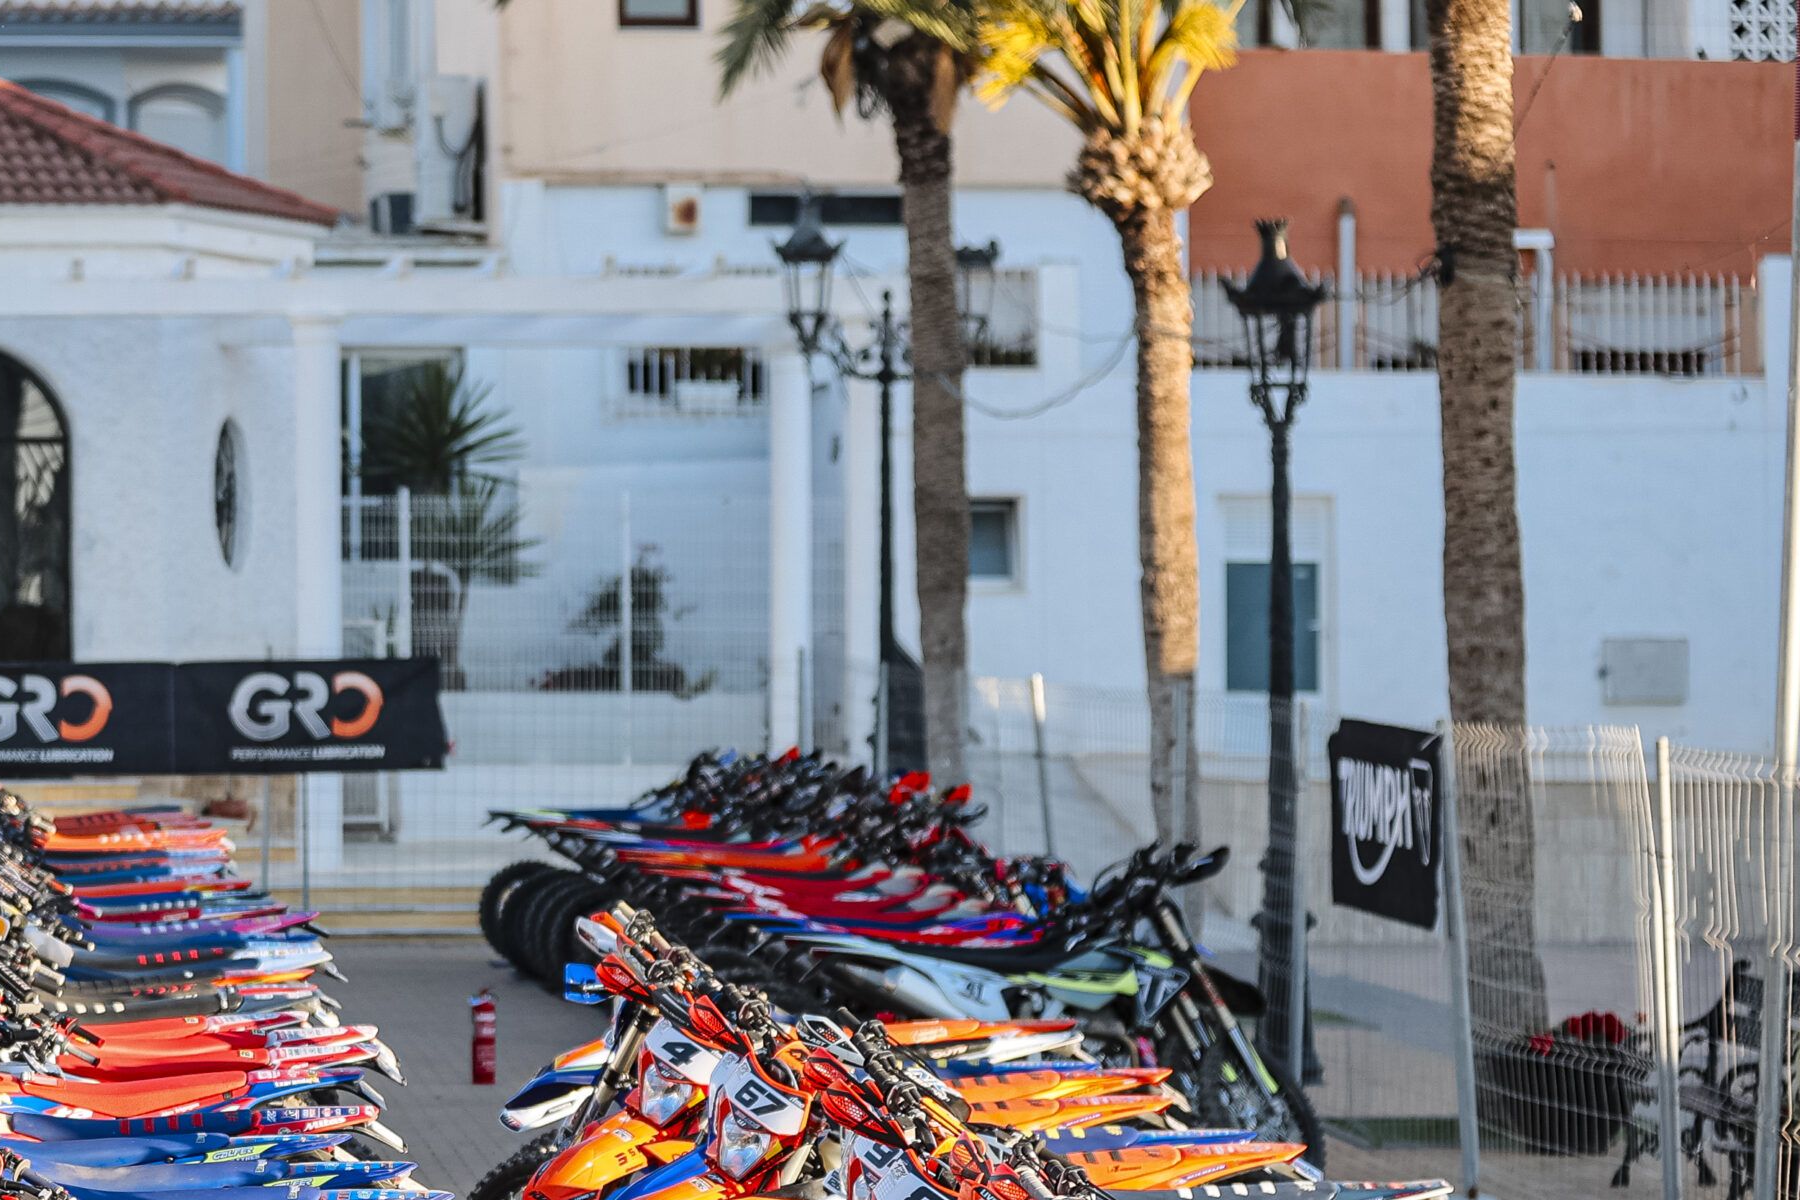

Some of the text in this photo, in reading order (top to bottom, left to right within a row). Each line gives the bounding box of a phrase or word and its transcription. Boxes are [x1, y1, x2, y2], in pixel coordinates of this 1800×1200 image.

[227, 671, 385, 741] GRO
[39, 747, 113, 763] LUBRICATION
[232, 744, 386, 762] PERFORMANCE LUBRICATION
[662, 1040, 697, 1066] 4
[733, 1079, 788, 1117] 67
